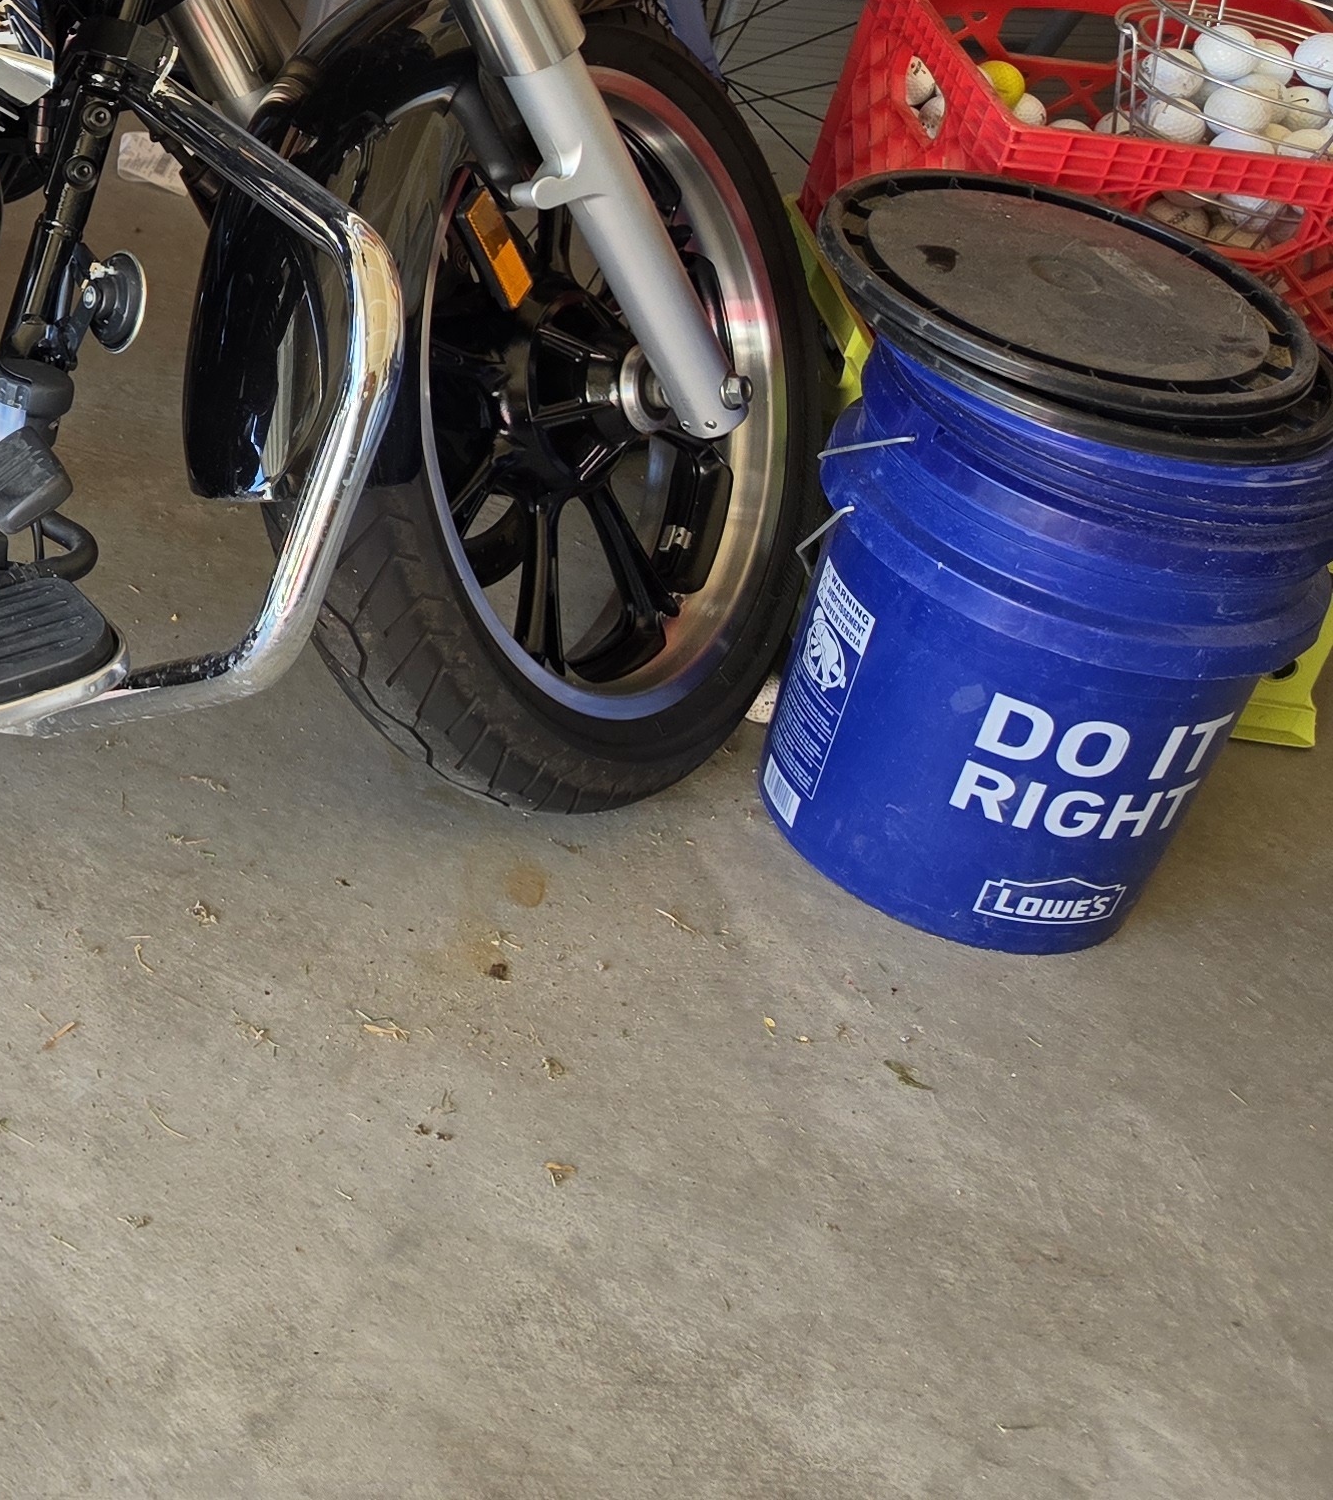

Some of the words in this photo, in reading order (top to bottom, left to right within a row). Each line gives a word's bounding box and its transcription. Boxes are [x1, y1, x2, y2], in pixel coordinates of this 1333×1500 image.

[831, 573, 870, 626] WARNING
[974, 692, 1131, 778] DO
[1147, 711, 1235, 780] IT
[949, 759, 1201, 840] RIGHT
[993, 888, 1112, 920] LOWE'S
